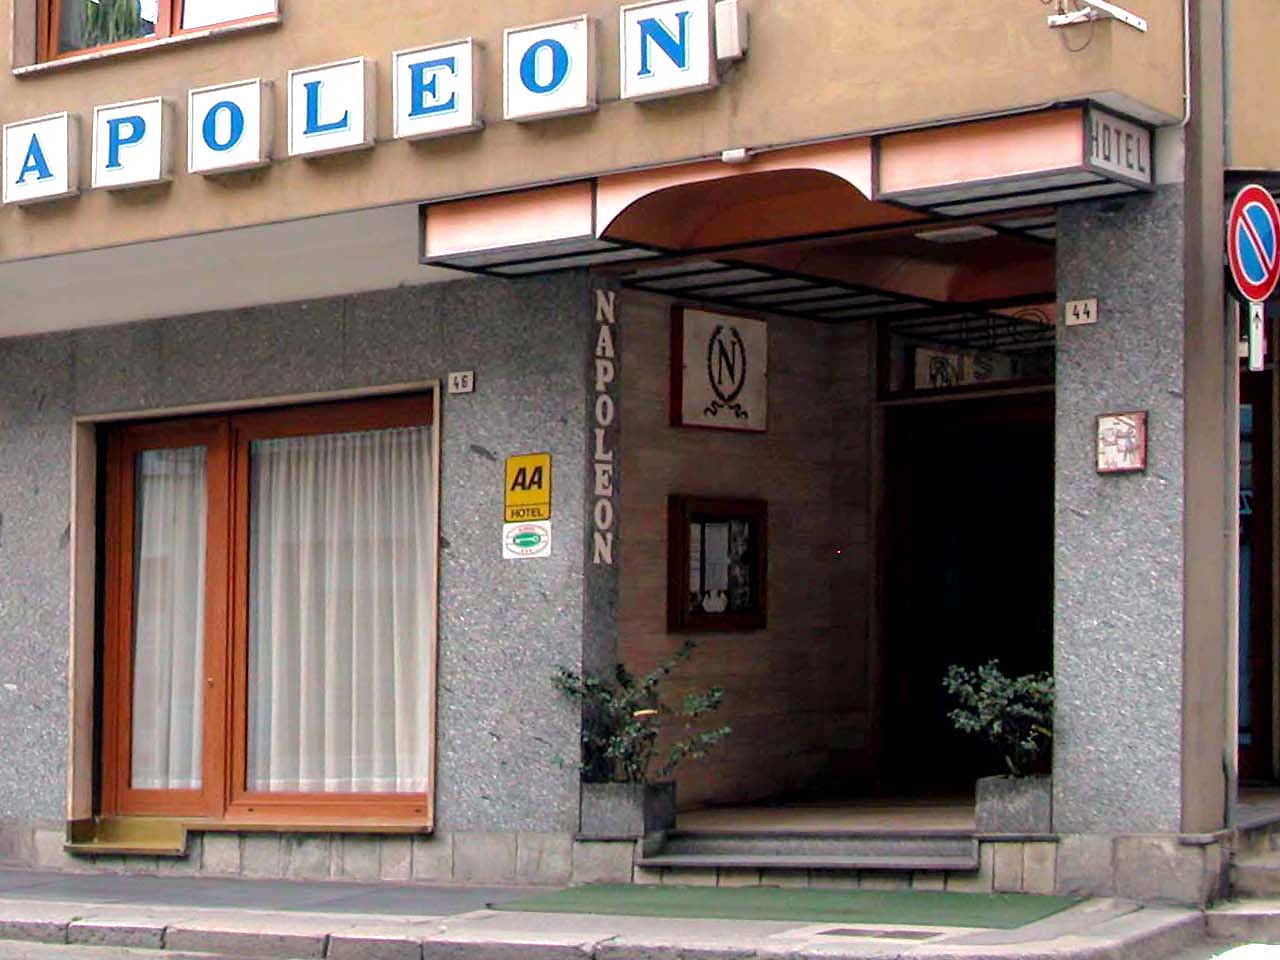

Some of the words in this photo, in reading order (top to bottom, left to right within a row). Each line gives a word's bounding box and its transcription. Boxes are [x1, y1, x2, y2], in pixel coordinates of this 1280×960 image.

[1090, 118, 1146, 173] HOTEL
[1072, 303, 1091, 320] 44
[452, 374, 469, 390] 46
[593, 289, 616, 565] NAPOLEON
[510, 465, 544, 492] AA
[510, 506, 544, 519] HOTEL
